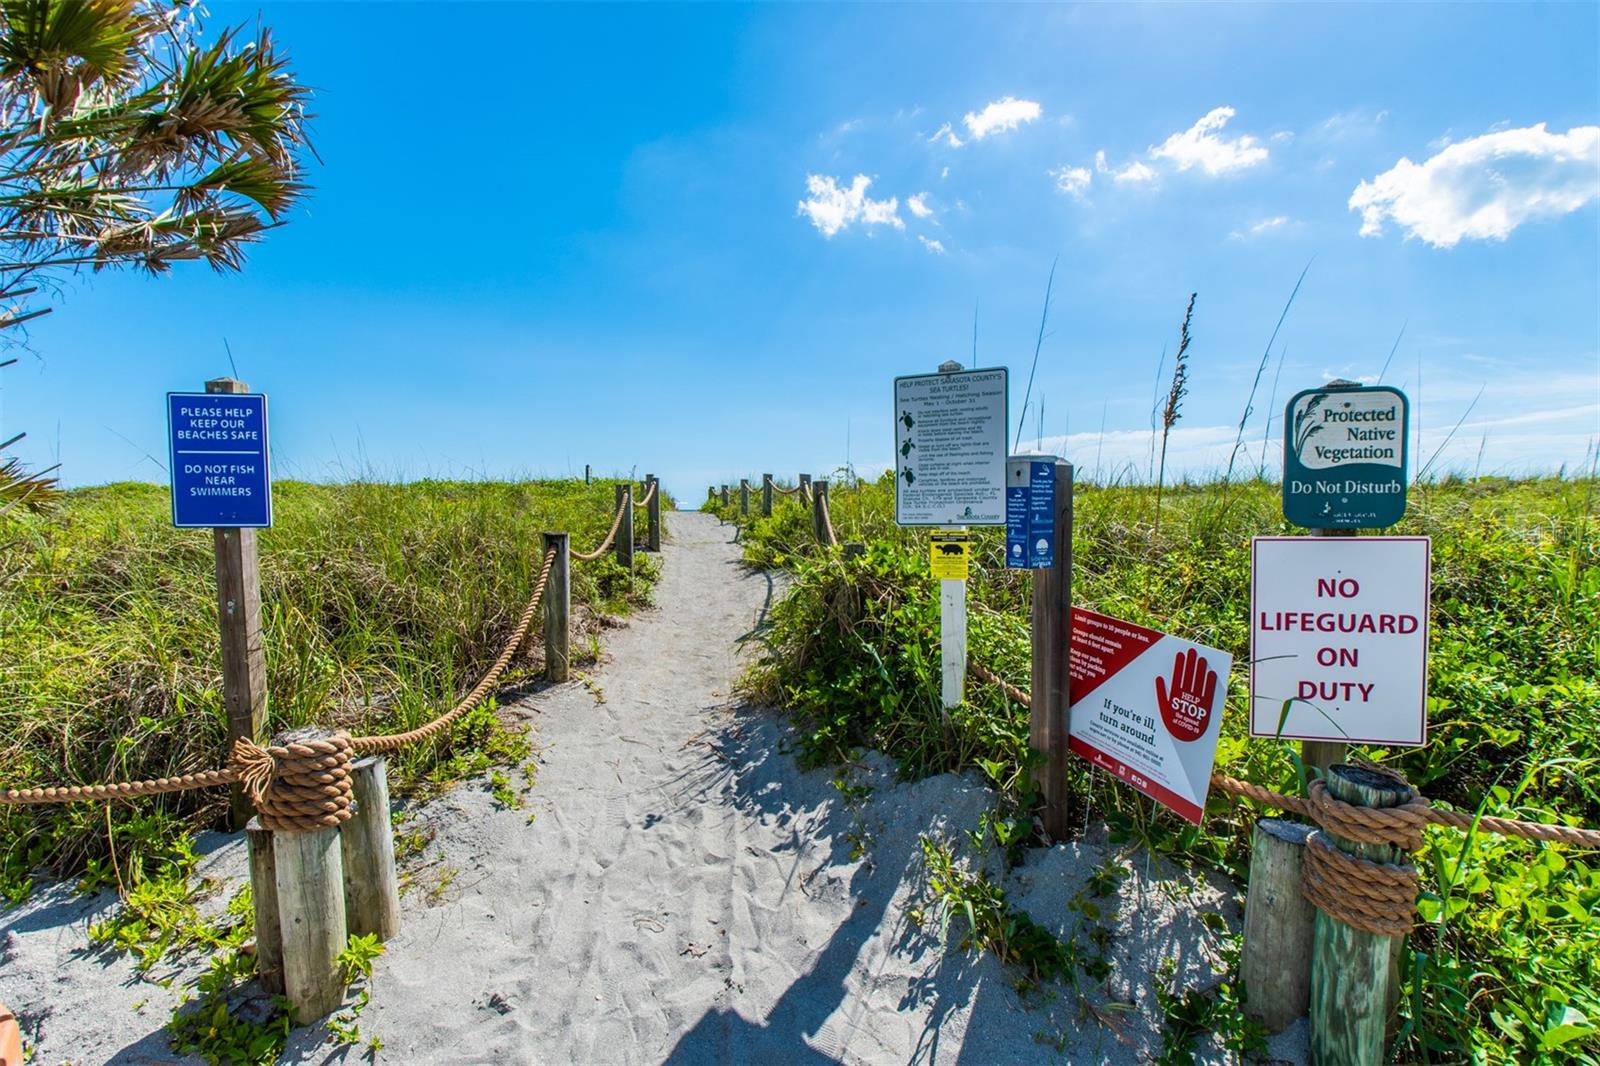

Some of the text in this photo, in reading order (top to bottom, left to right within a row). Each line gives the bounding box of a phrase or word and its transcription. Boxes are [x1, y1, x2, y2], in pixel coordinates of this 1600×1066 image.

[972, 374, 1002, 382] COUNTY'S
[181, 408, 252, 417] PLEASE HELP
[1323, 406, 1395, 422] Protected
[190, 420, 244, 428] KEEP OUR
[178, 430, 258, 440] BEACHES SAFE
[1346, 427, 1395, 441] Native
[1314, 445, 1394, 463] Vegetation
[184, 465, 254, 474] DO NOT FISH
[205, 476, 235, 485] NEAR
[1291, 480, 1400, 494] Do Not Disturb
[190, 488, 252, 496] SWIMMERS
[1317, 578, 1360, 598] NO
[1087, 619, 1102, 627] groups
[1114, 628, 1131, 636] people
[1137, 633, 1149, 642] less.
[1260, 612, 1418, 634] LIFEGUARD
[1073, 628, 1122, 648] Groups should remain
[1316, 647, 1358, 667] ON
[1182, 692, 1200, 704] HELP
[1298, 681, 1374, 702] DUTY
[1104, 698, 1156, 732] If you're ill,
[1172, 698, 1206, 720] STOP
[1100, 712, 1118, 728] turn
[1120, 724, 1155, 746] around.
